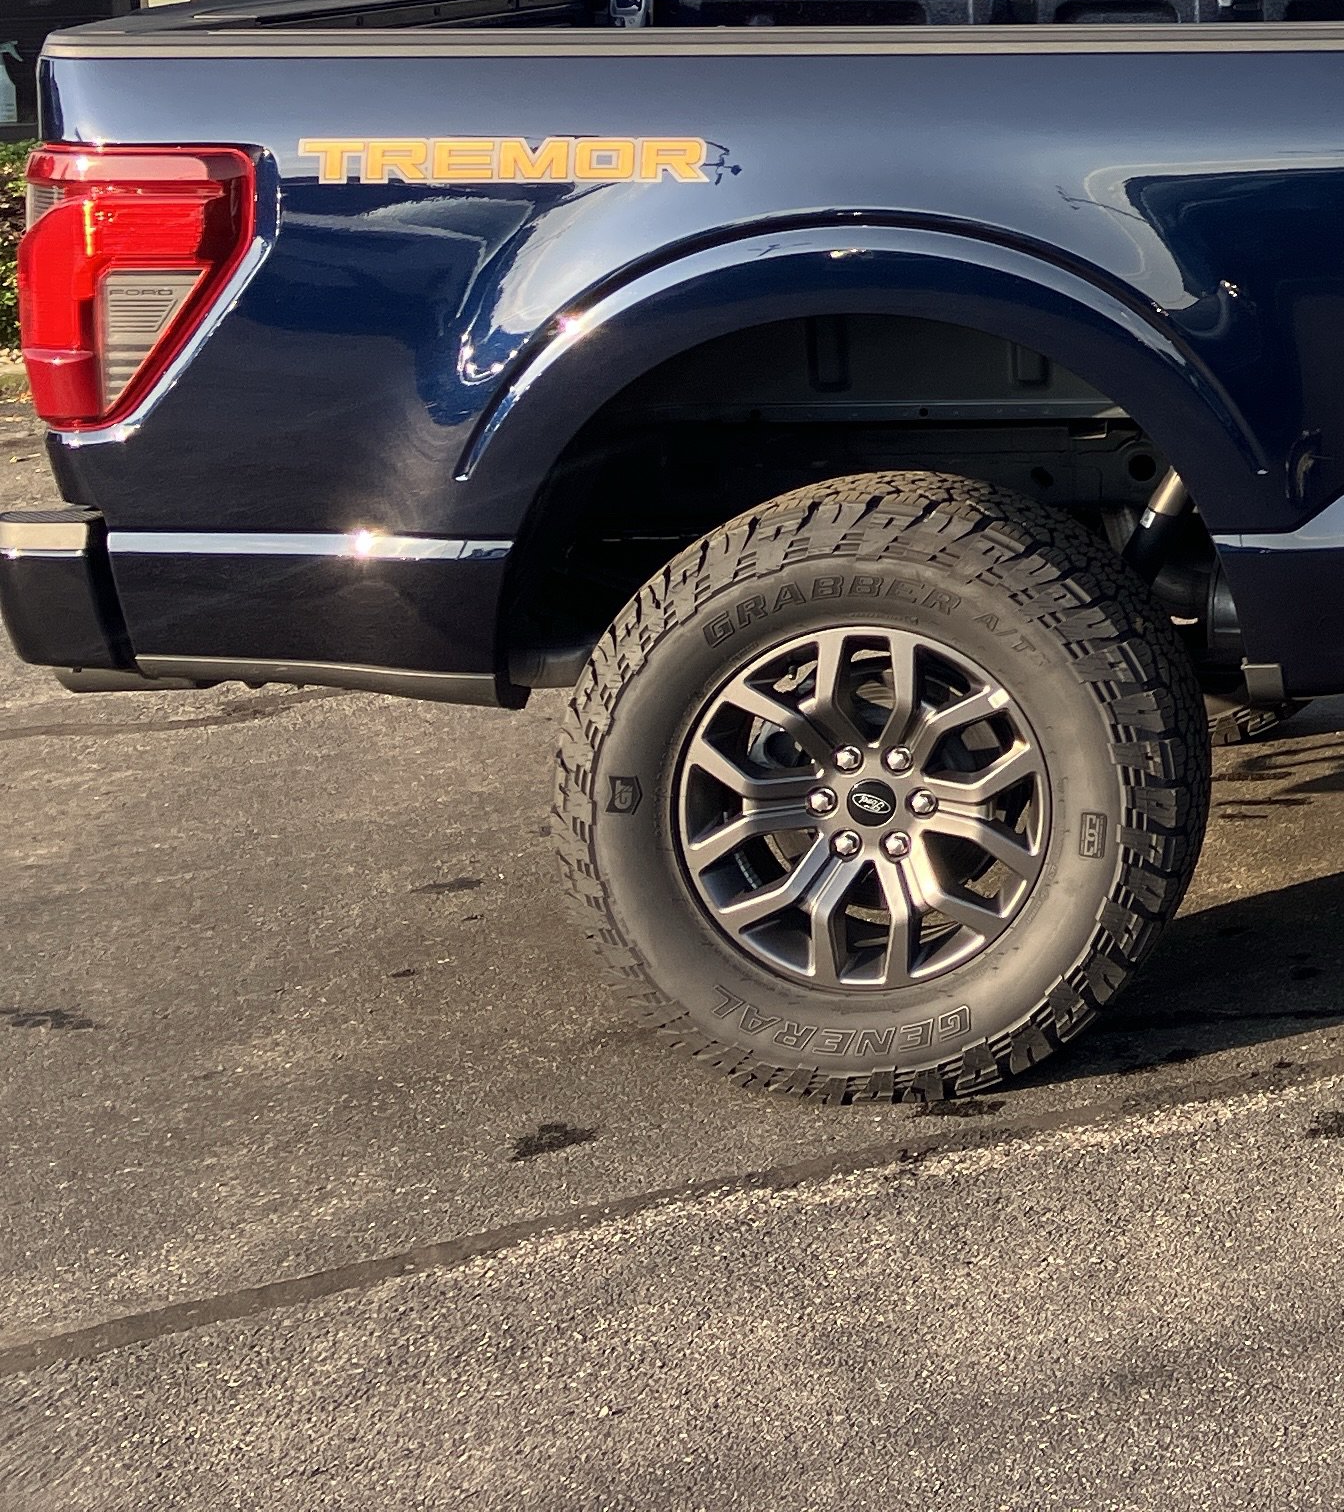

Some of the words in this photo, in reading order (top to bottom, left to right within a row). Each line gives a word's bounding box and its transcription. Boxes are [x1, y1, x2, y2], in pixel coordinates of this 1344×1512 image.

[299, 135, 710, 185] TREMOR
[702, 574, 962, 648] GRABBER
[711, 984, 972, 1057] GENERAL
